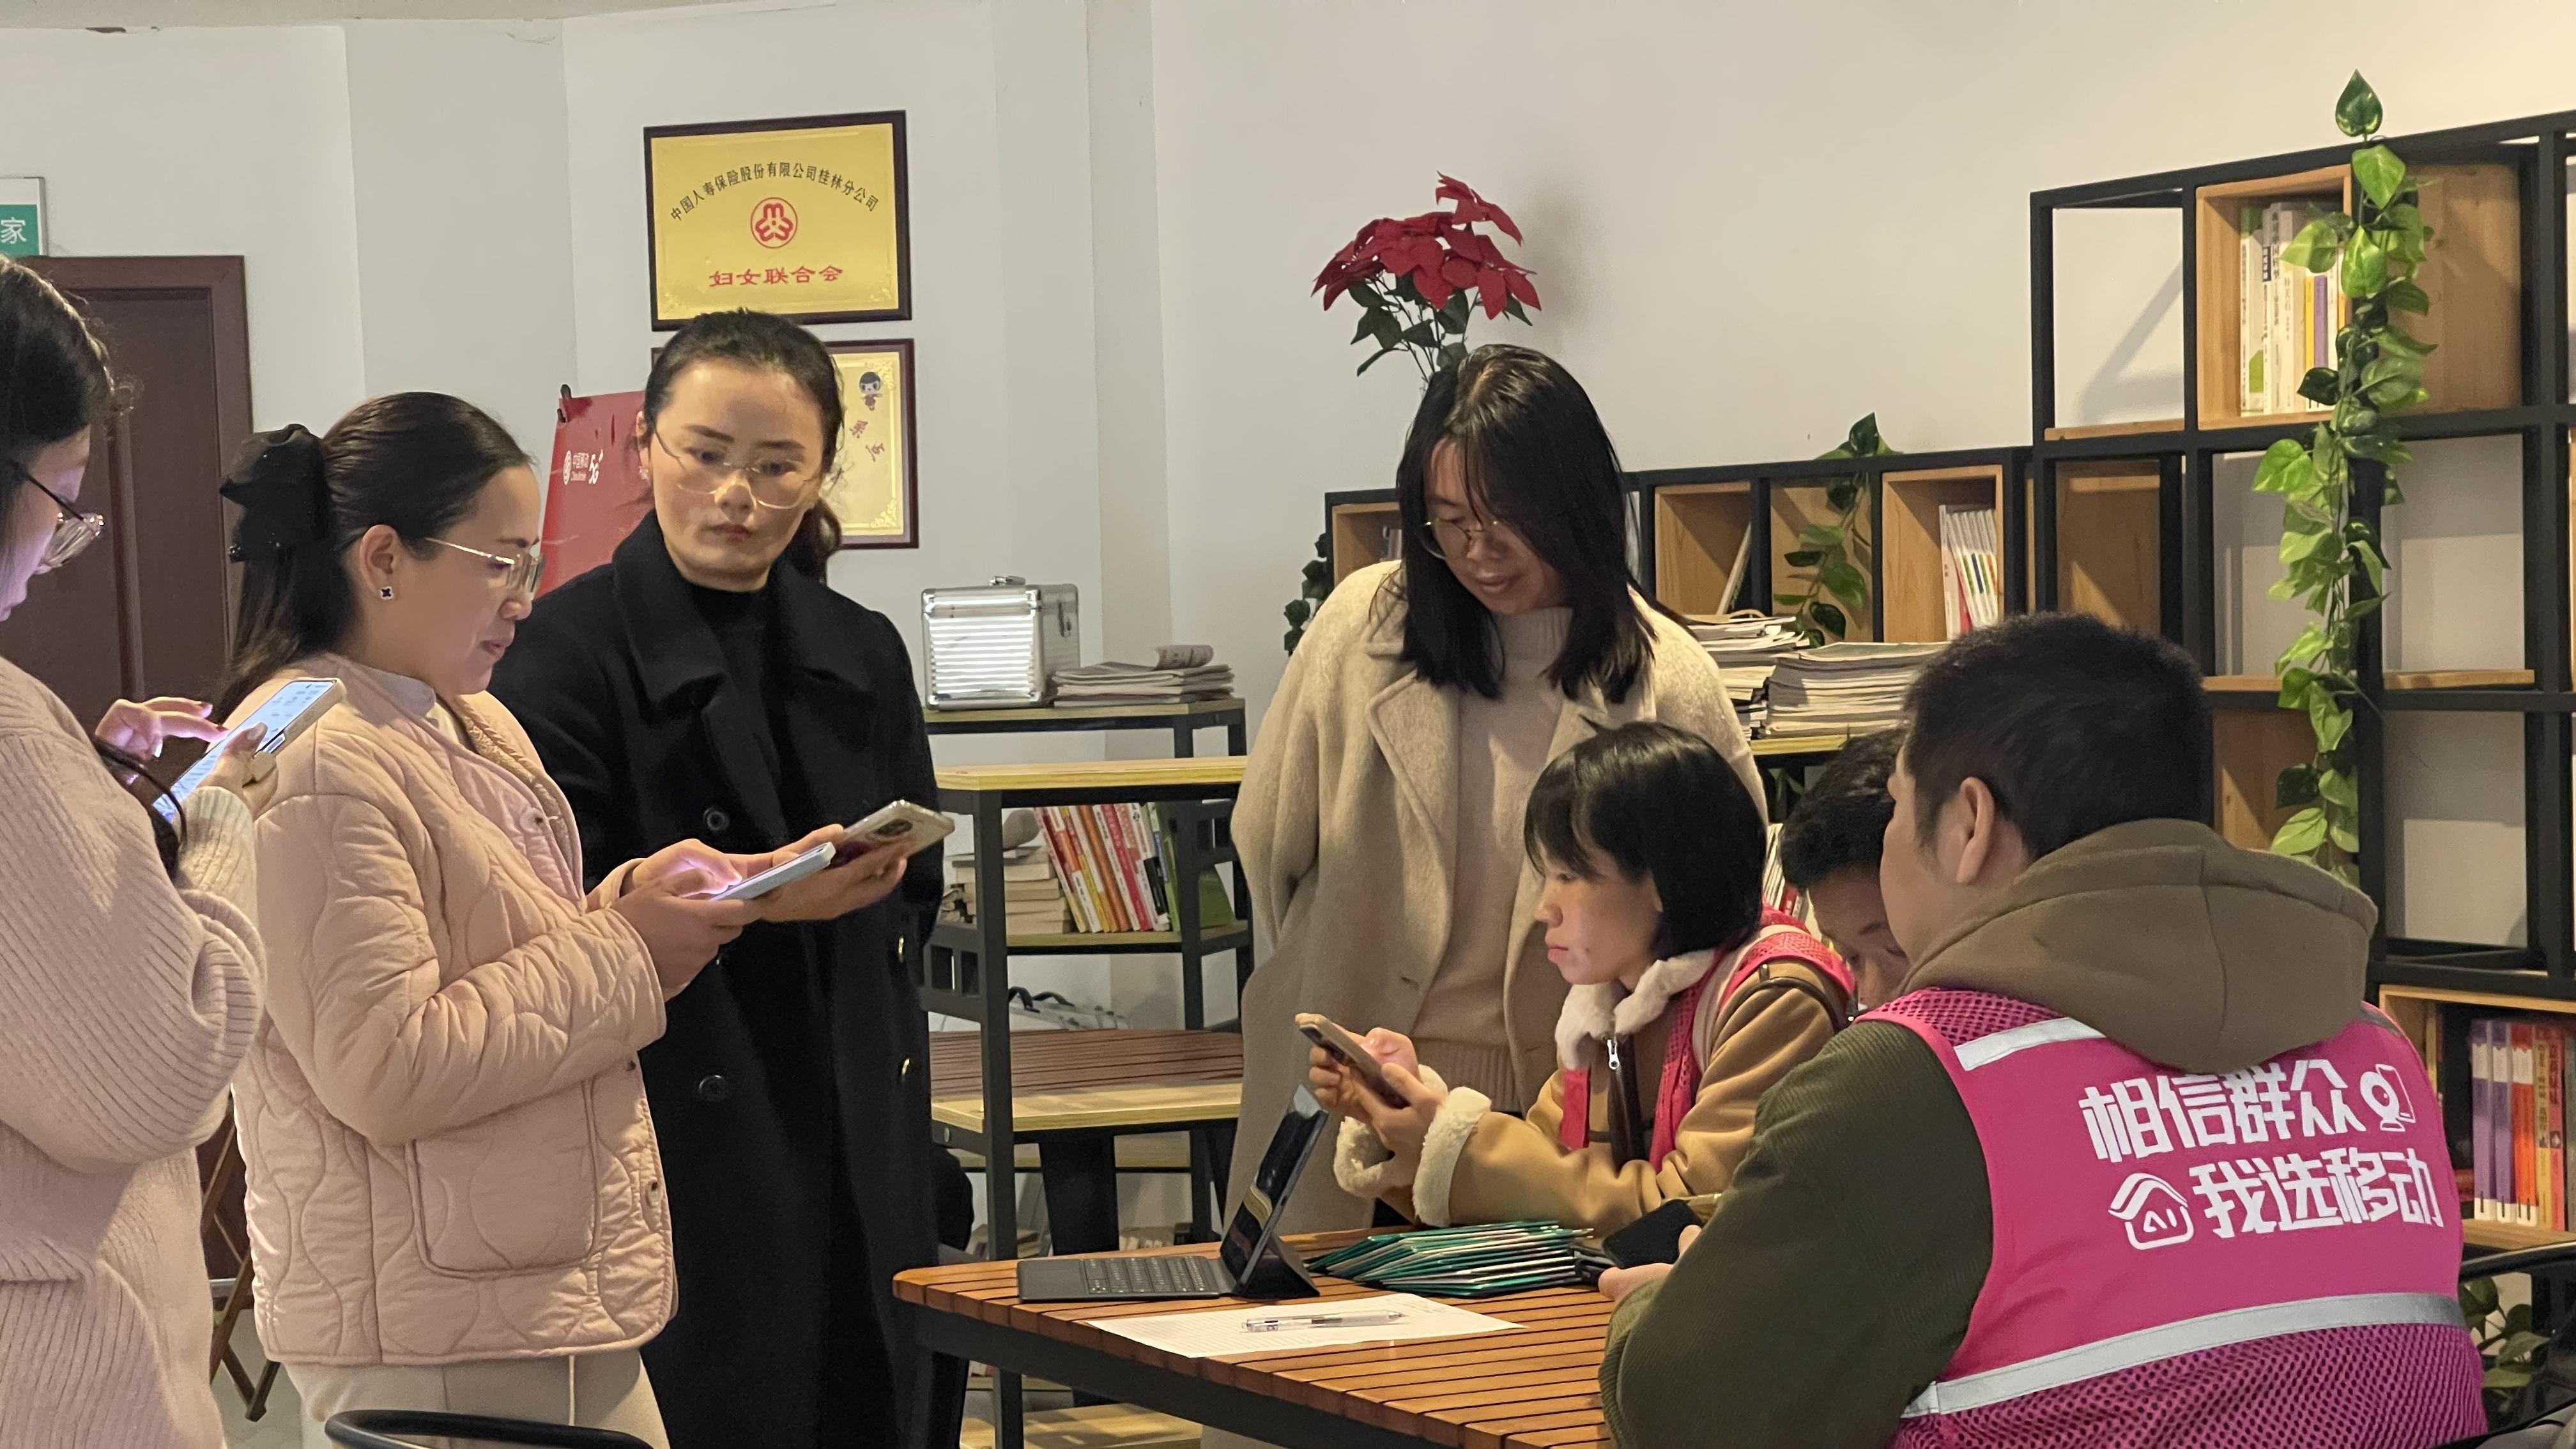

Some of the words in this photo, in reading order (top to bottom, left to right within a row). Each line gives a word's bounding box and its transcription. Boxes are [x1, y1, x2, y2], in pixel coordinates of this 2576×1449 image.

[671, 162, 878, 222] 中国人寿保险股份有限公司桂林分公司
[1, 217, 27, 244] 家
[709, 266, 843, 287] 妇女联合会
[2078, 1059, 2366, 1163] 相信群众
[2189, 1147, 2444, 1238] 我选移动
[2143, 1208, 2177, 1233] AI
